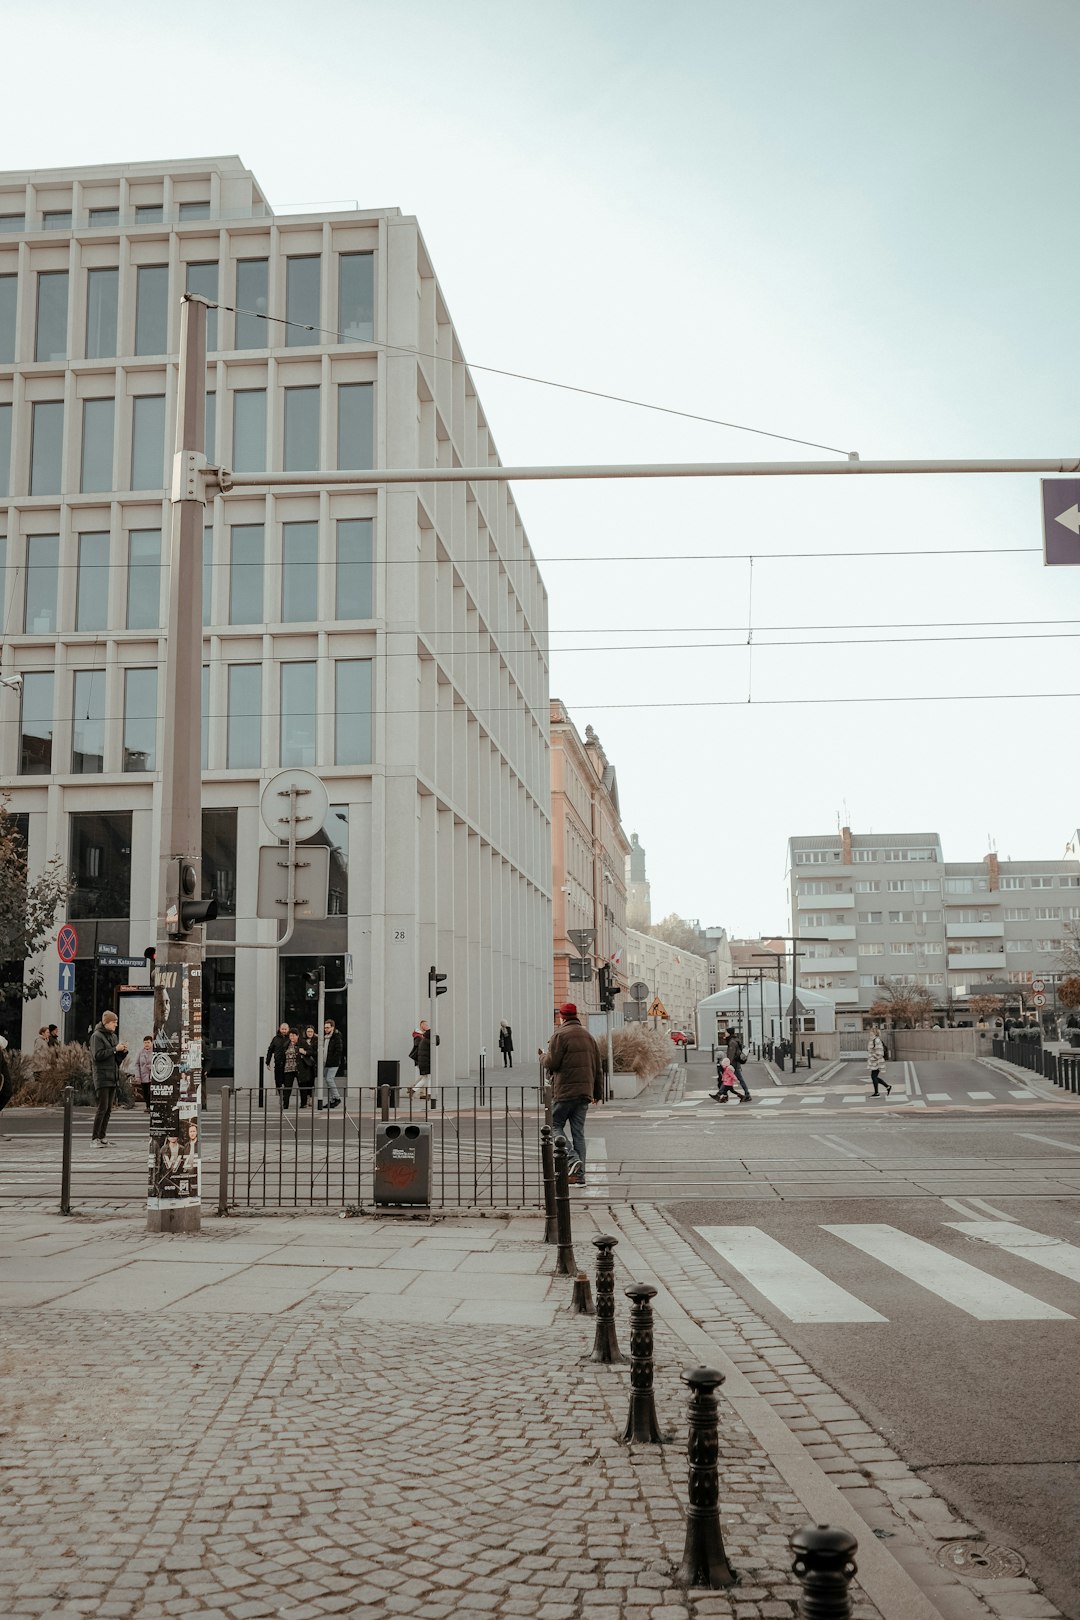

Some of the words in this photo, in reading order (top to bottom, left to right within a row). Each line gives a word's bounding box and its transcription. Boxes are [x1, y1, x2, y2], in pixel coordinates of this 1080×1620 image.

[394, 931, 406, 940] 28
[117, 958, 145, 967] Katarzyny
[1037, 995, 1043, 1005] 5
